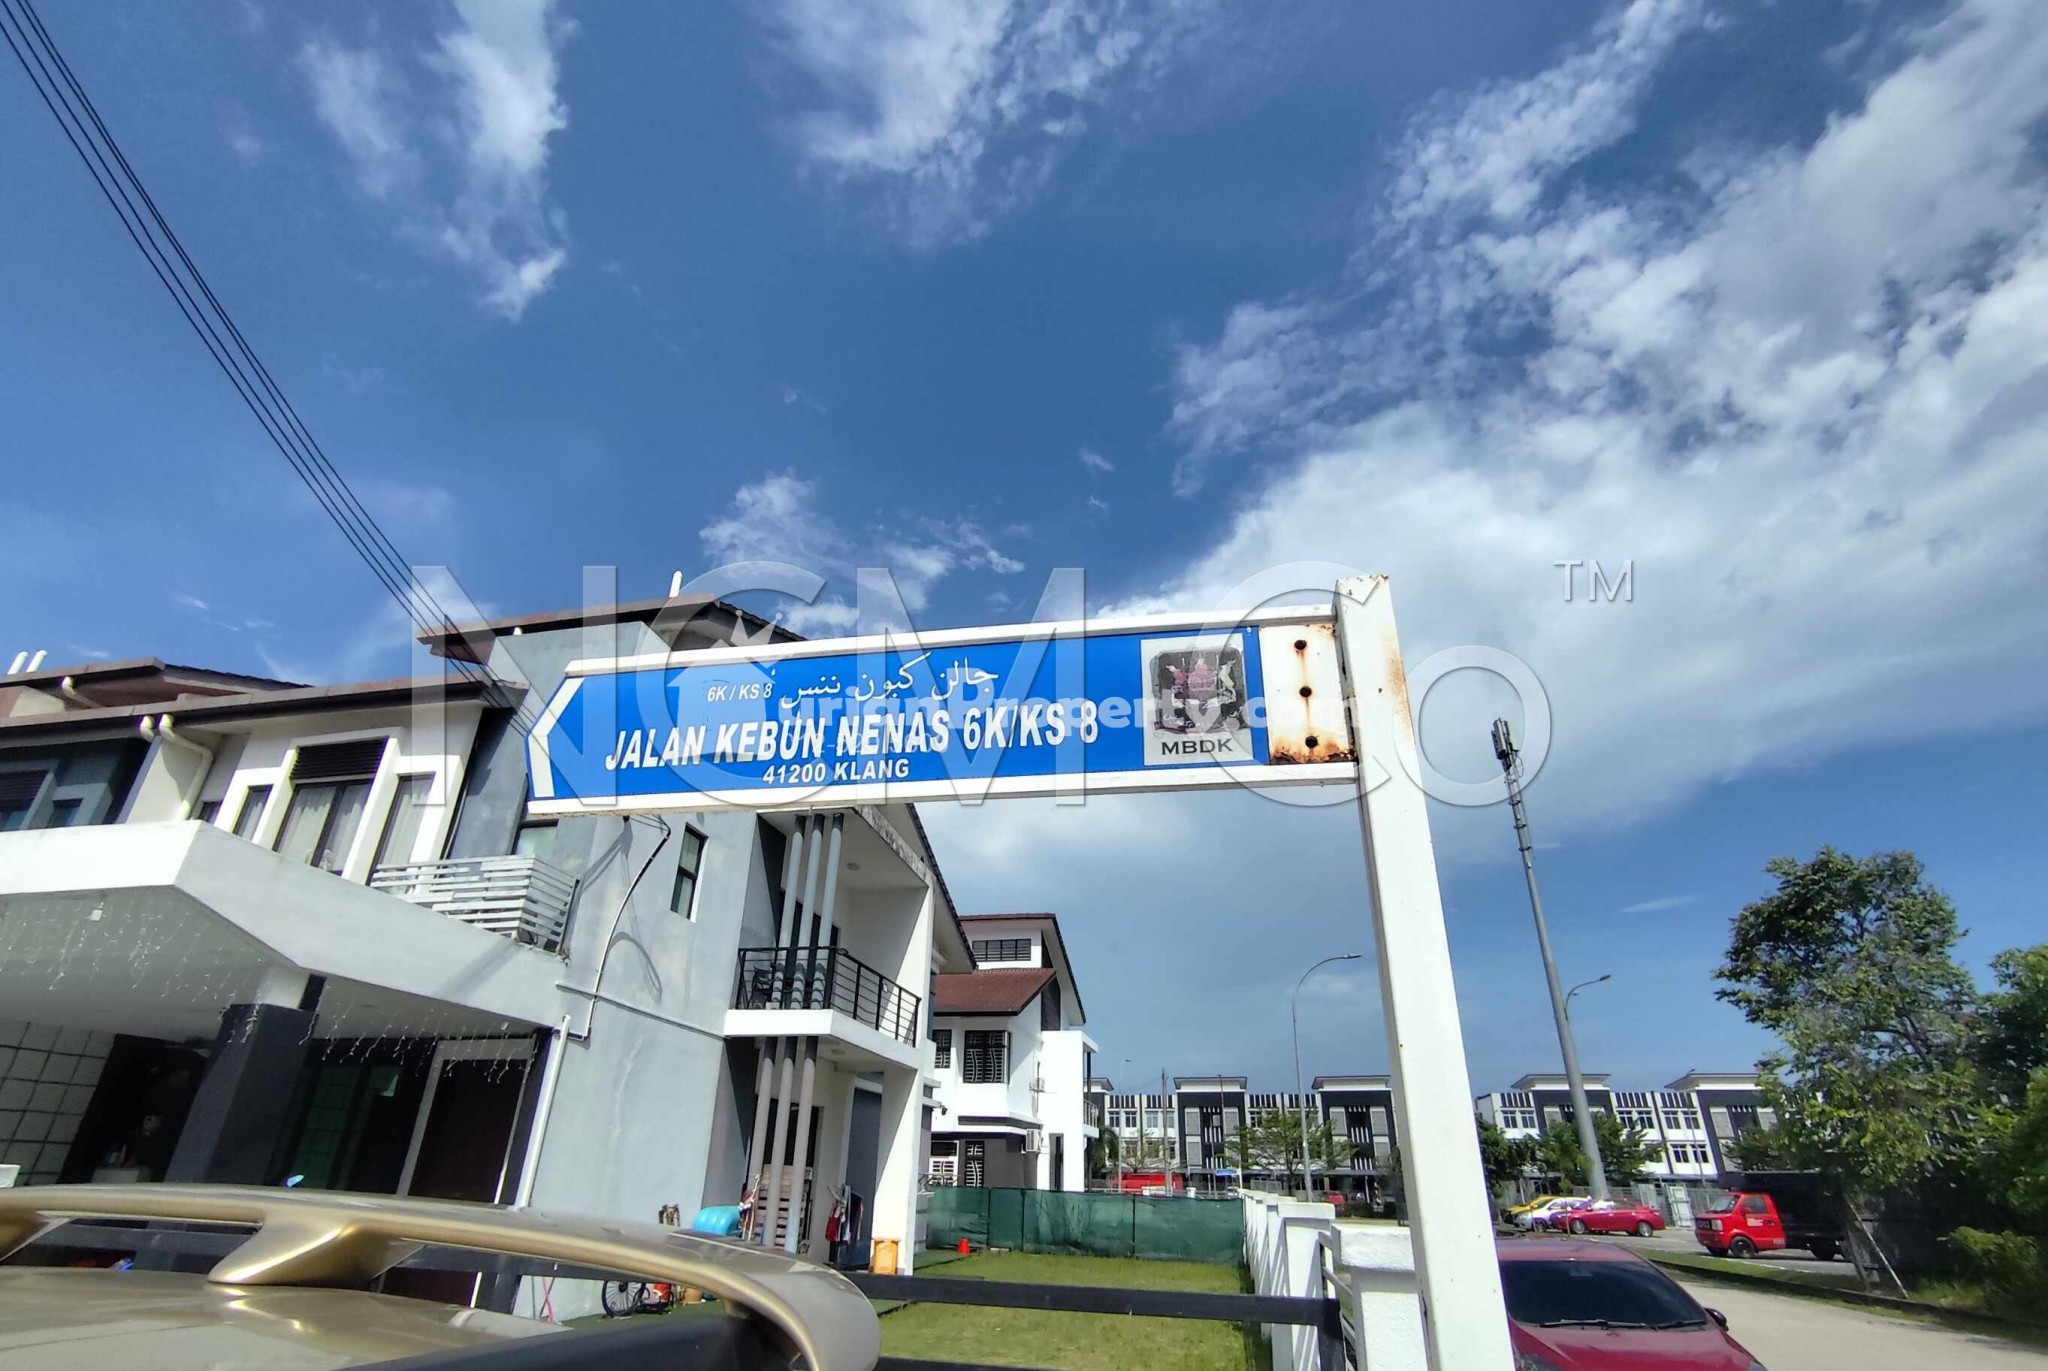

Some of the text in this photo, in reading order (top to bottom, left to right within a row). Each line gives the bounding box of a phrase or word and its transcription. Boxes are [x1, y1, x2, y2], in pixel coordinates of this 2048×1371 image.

[605, 724, 708, 772] JALAN
[714, 717, 825, 764] KEBUN
[837, 709, 950, 757] NENAS
[963, 701, 1066, 750] 6K/KS
[1079, 701, 1099, 744] 8
[1161, 738, 1234, 756] MBDK
[762, 758, 910, 784] 41200 KLANG
